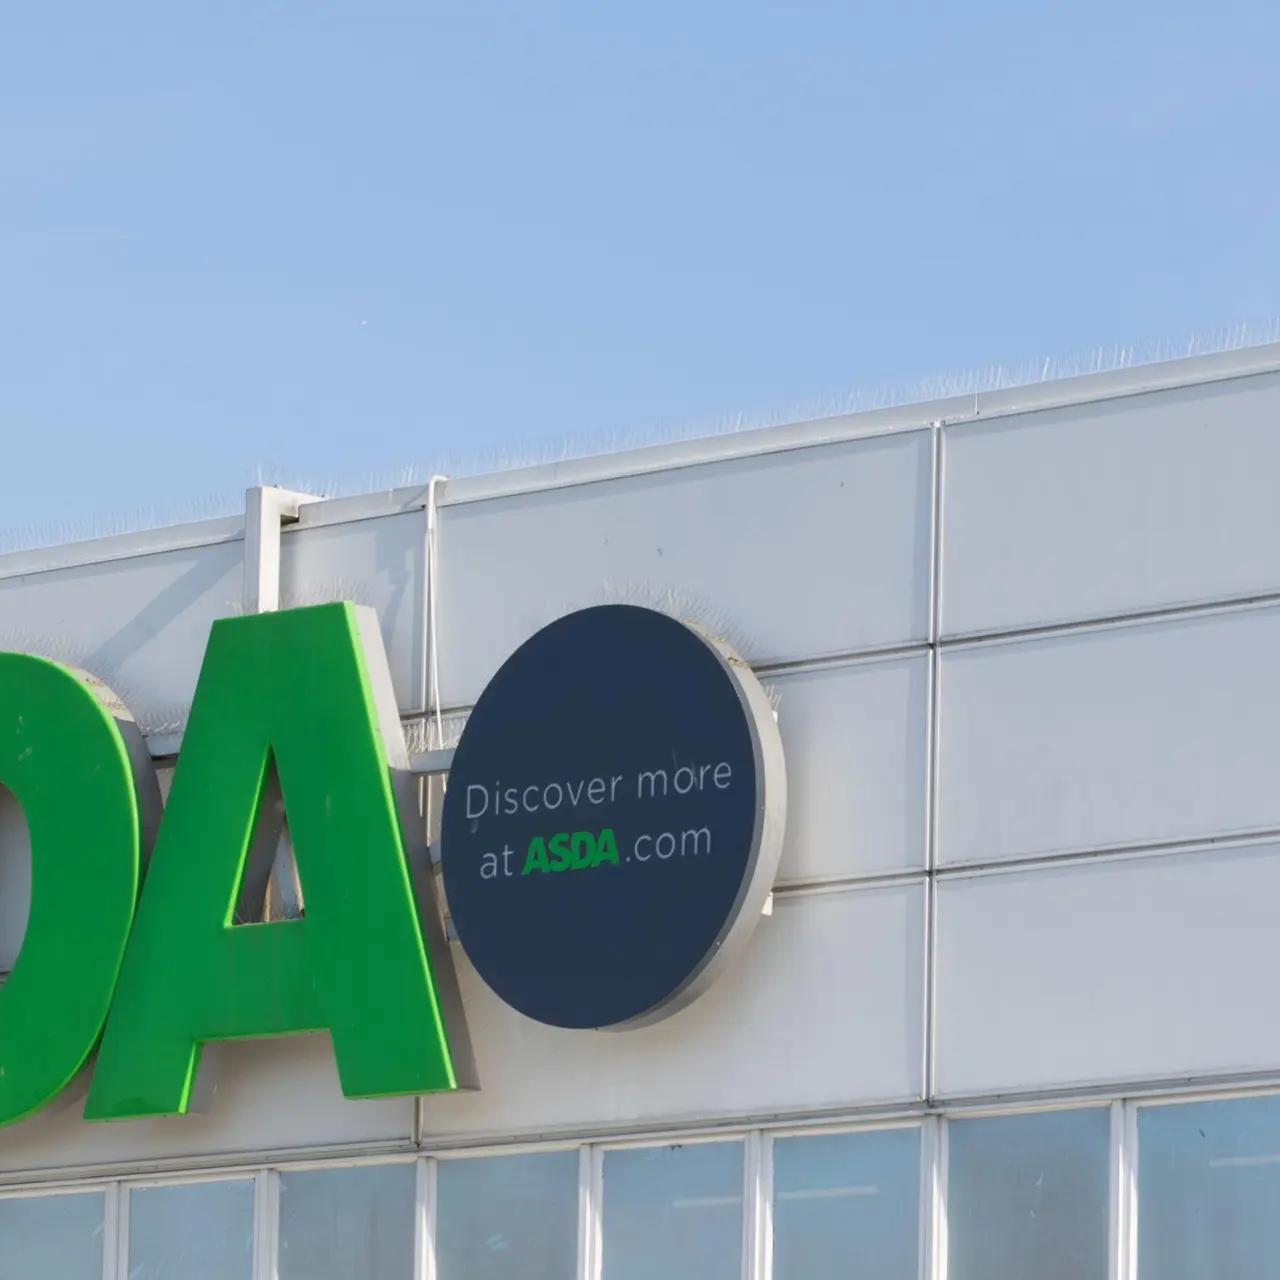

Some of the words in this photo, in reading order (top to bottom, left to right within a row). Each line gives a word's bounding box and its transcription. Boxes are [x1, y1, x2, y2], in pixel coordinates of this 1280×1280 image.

[466, 775, 623, 818] Discover
[638, 762, 732, 798] more
[479, 844, 514, 879] at
